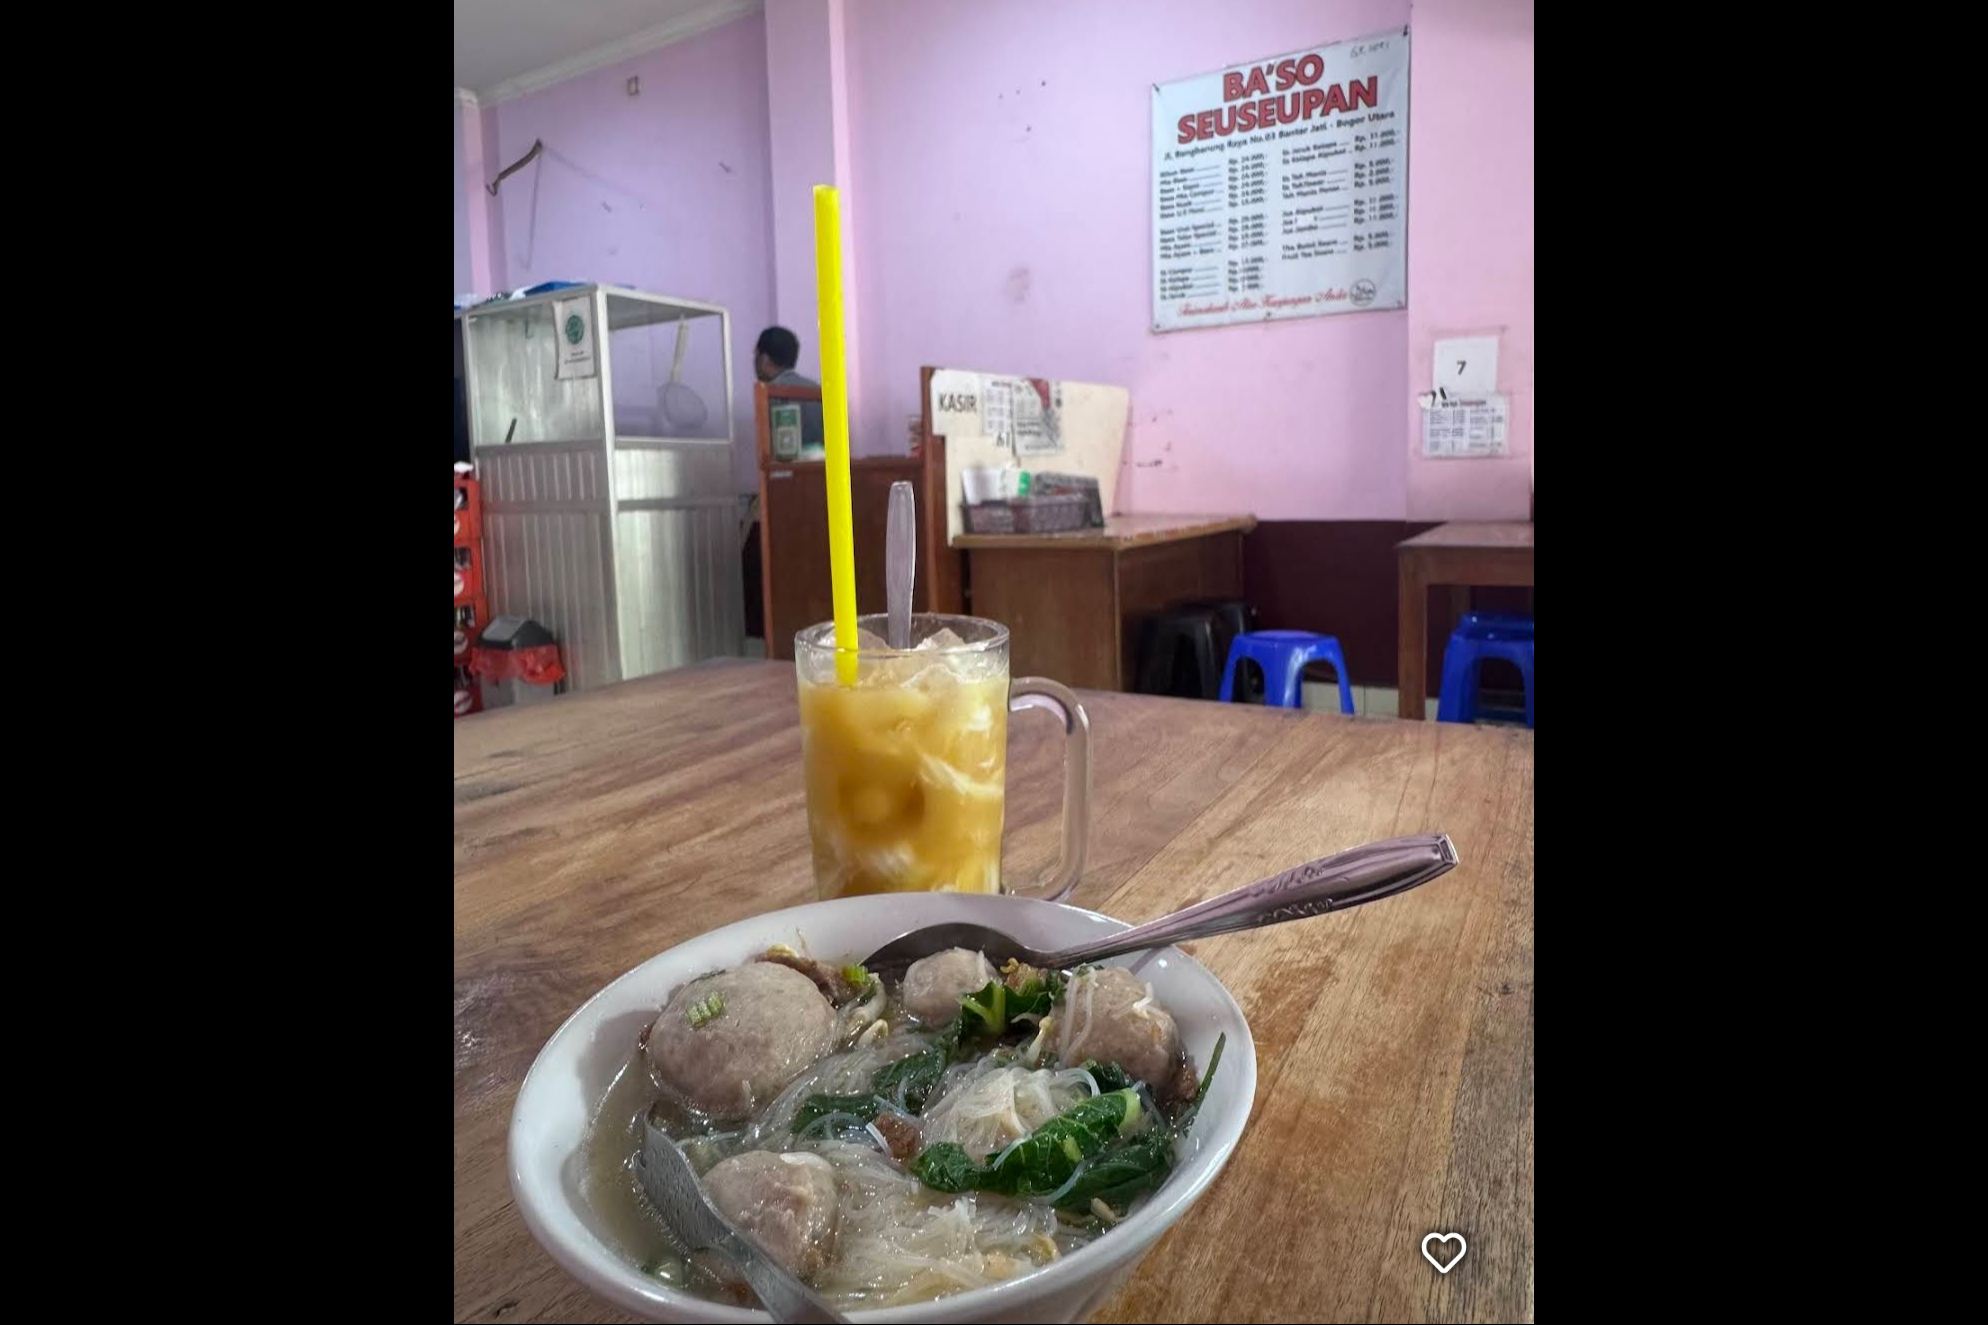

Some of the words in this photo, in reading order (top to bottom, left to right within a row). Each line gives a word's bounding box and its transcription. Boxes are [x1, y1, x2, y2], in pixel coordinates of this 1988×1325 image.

[1222, 53, 1325, 103] BA'SO
[1177, 75, 1379, 144] SEUSEUPAN
[1336, 116, 1365, 128] Bogor
[1367, 110, 1394, 122] Utara
[1457, 360, 1466, 375] 7
[938, 393, 977, 413] KASIR
